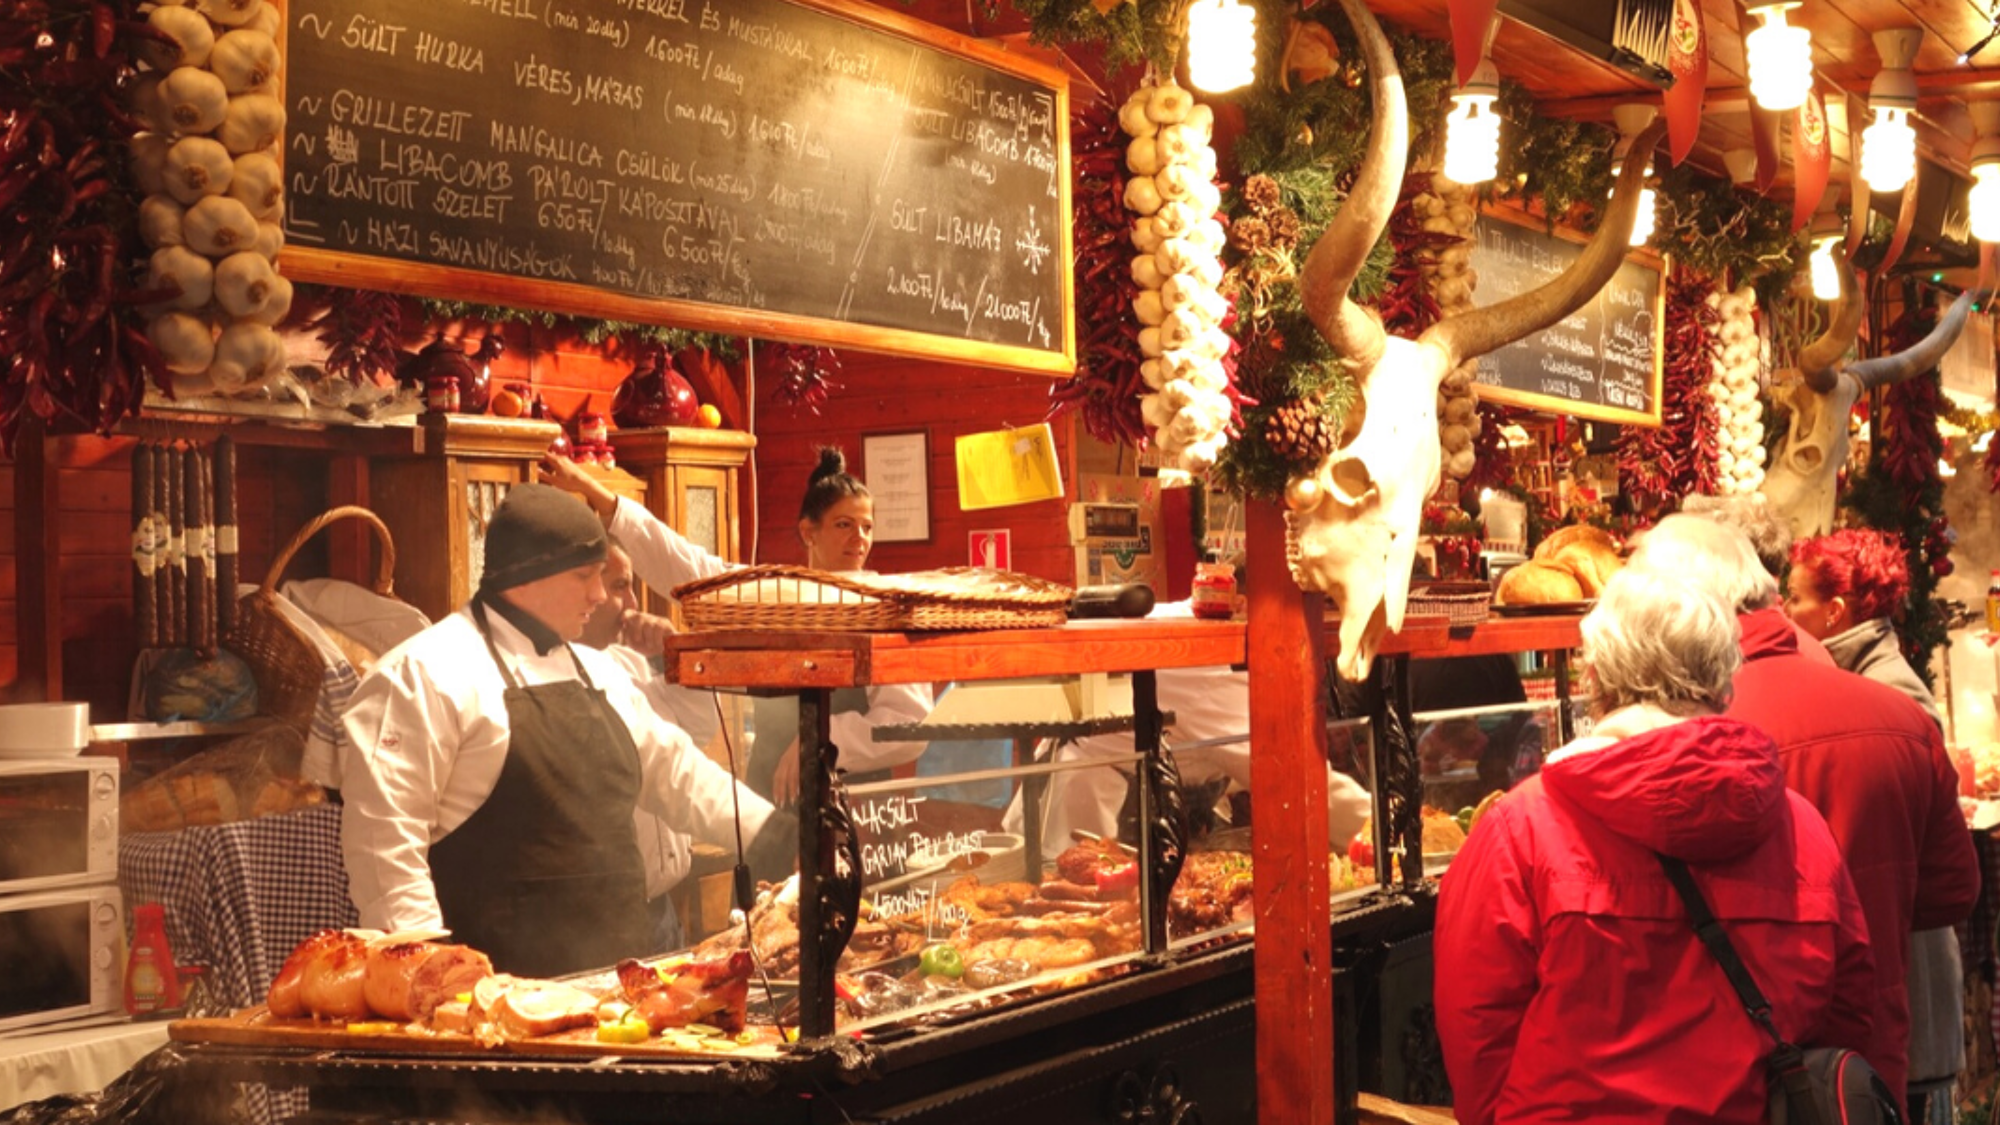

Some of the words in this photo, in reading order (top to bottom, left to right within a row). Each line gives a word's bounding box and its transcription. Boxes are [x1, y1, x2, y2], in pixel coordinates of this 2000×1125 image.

[341, 14, 406, 56] SÜLT
[415, 31, 484, 74] HURKA
[330, 88, 472, 142] GRILLEZETT
[490, 119, 603, 168] MANGALICA
[616, 148, 684, 185] CSÜLÖK
[951, 115, 1019, 161] LIBACOMB
[322, 161, 420, 210] RÁNTOTT
[432, 186, 513, 223] SZELET
[380, 138, 513, 192] LIBACOMB
[527, 163, 615, 205] PÁROLT
[619, 186, 746, 243] KÁPOSZTÁVAL
[889, 198, 927, 235] SÜLT
[367, 217, 420, 255] HÁZI
